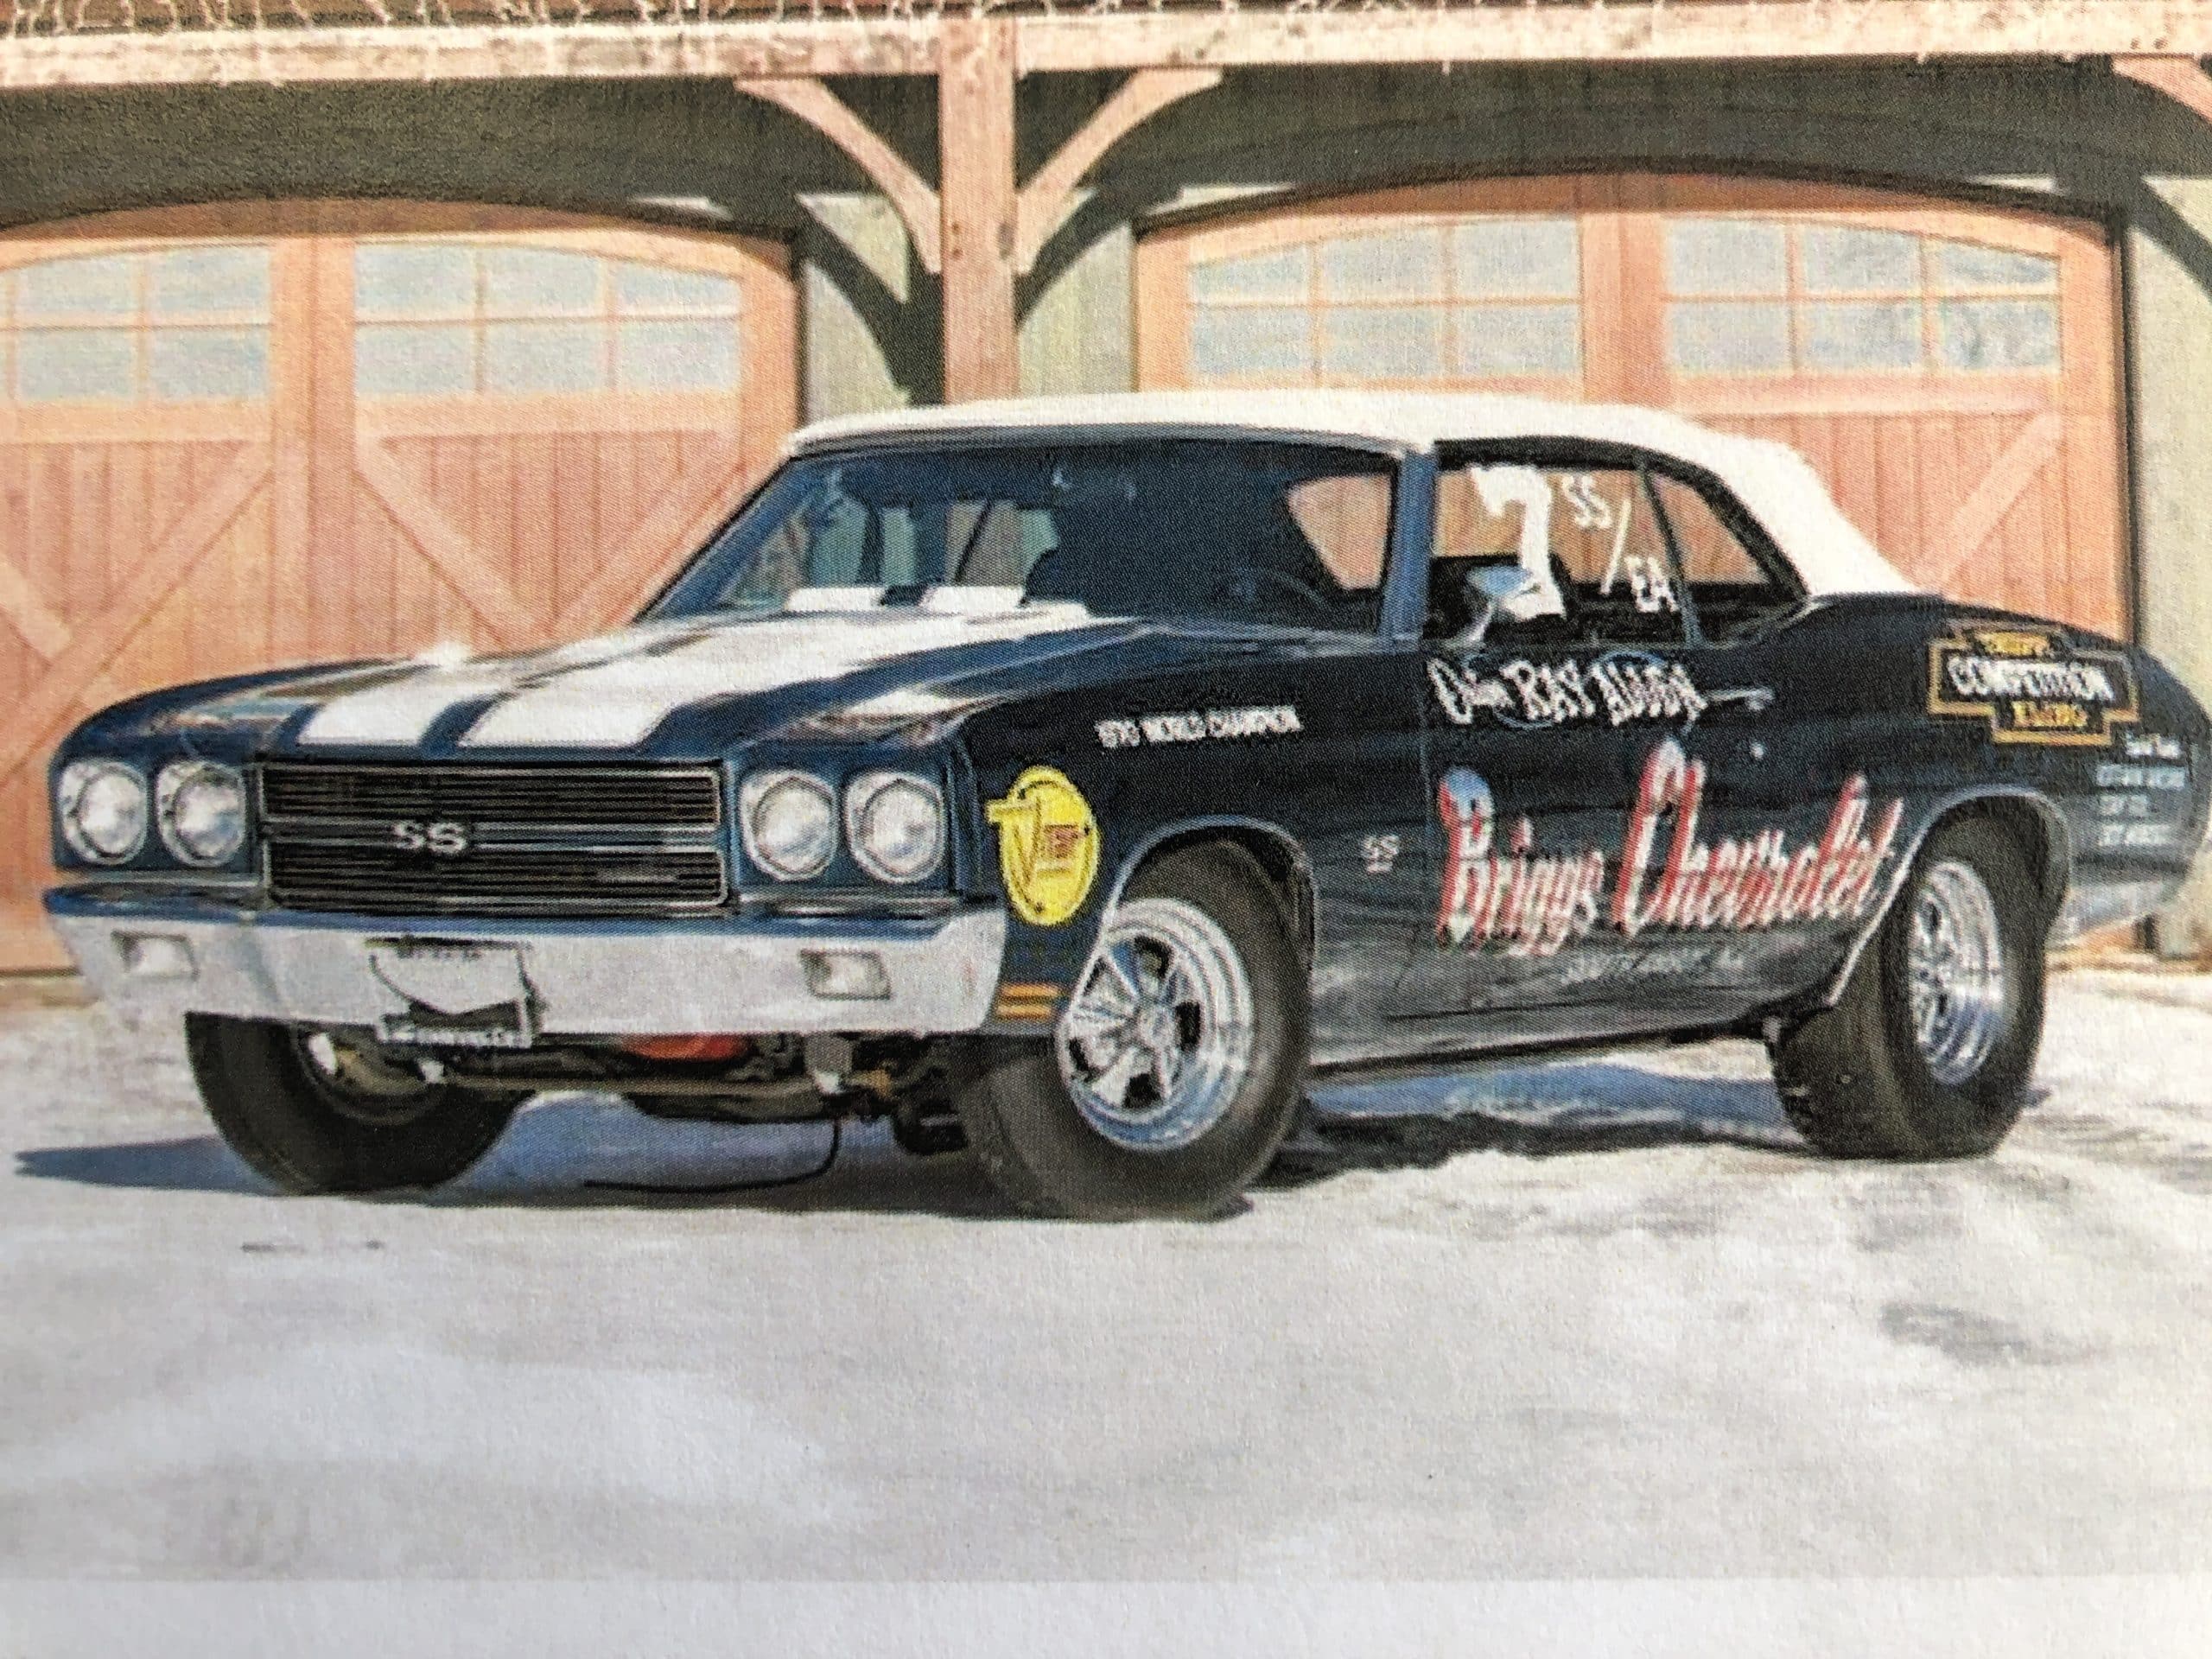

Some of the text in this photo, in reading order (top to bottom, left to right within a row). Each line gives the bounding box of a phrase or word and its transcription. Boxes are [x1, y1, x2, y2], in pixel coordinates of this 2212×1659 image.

[1946, 654, 2115, 702] COMPETITION
[1139, 711, 1206, 744] WORLD
[1207, 704, 1303, 739] CHAMPION
[391, 820, 469, 854] SS
[1434, 766, 1603, 956] Briggs
